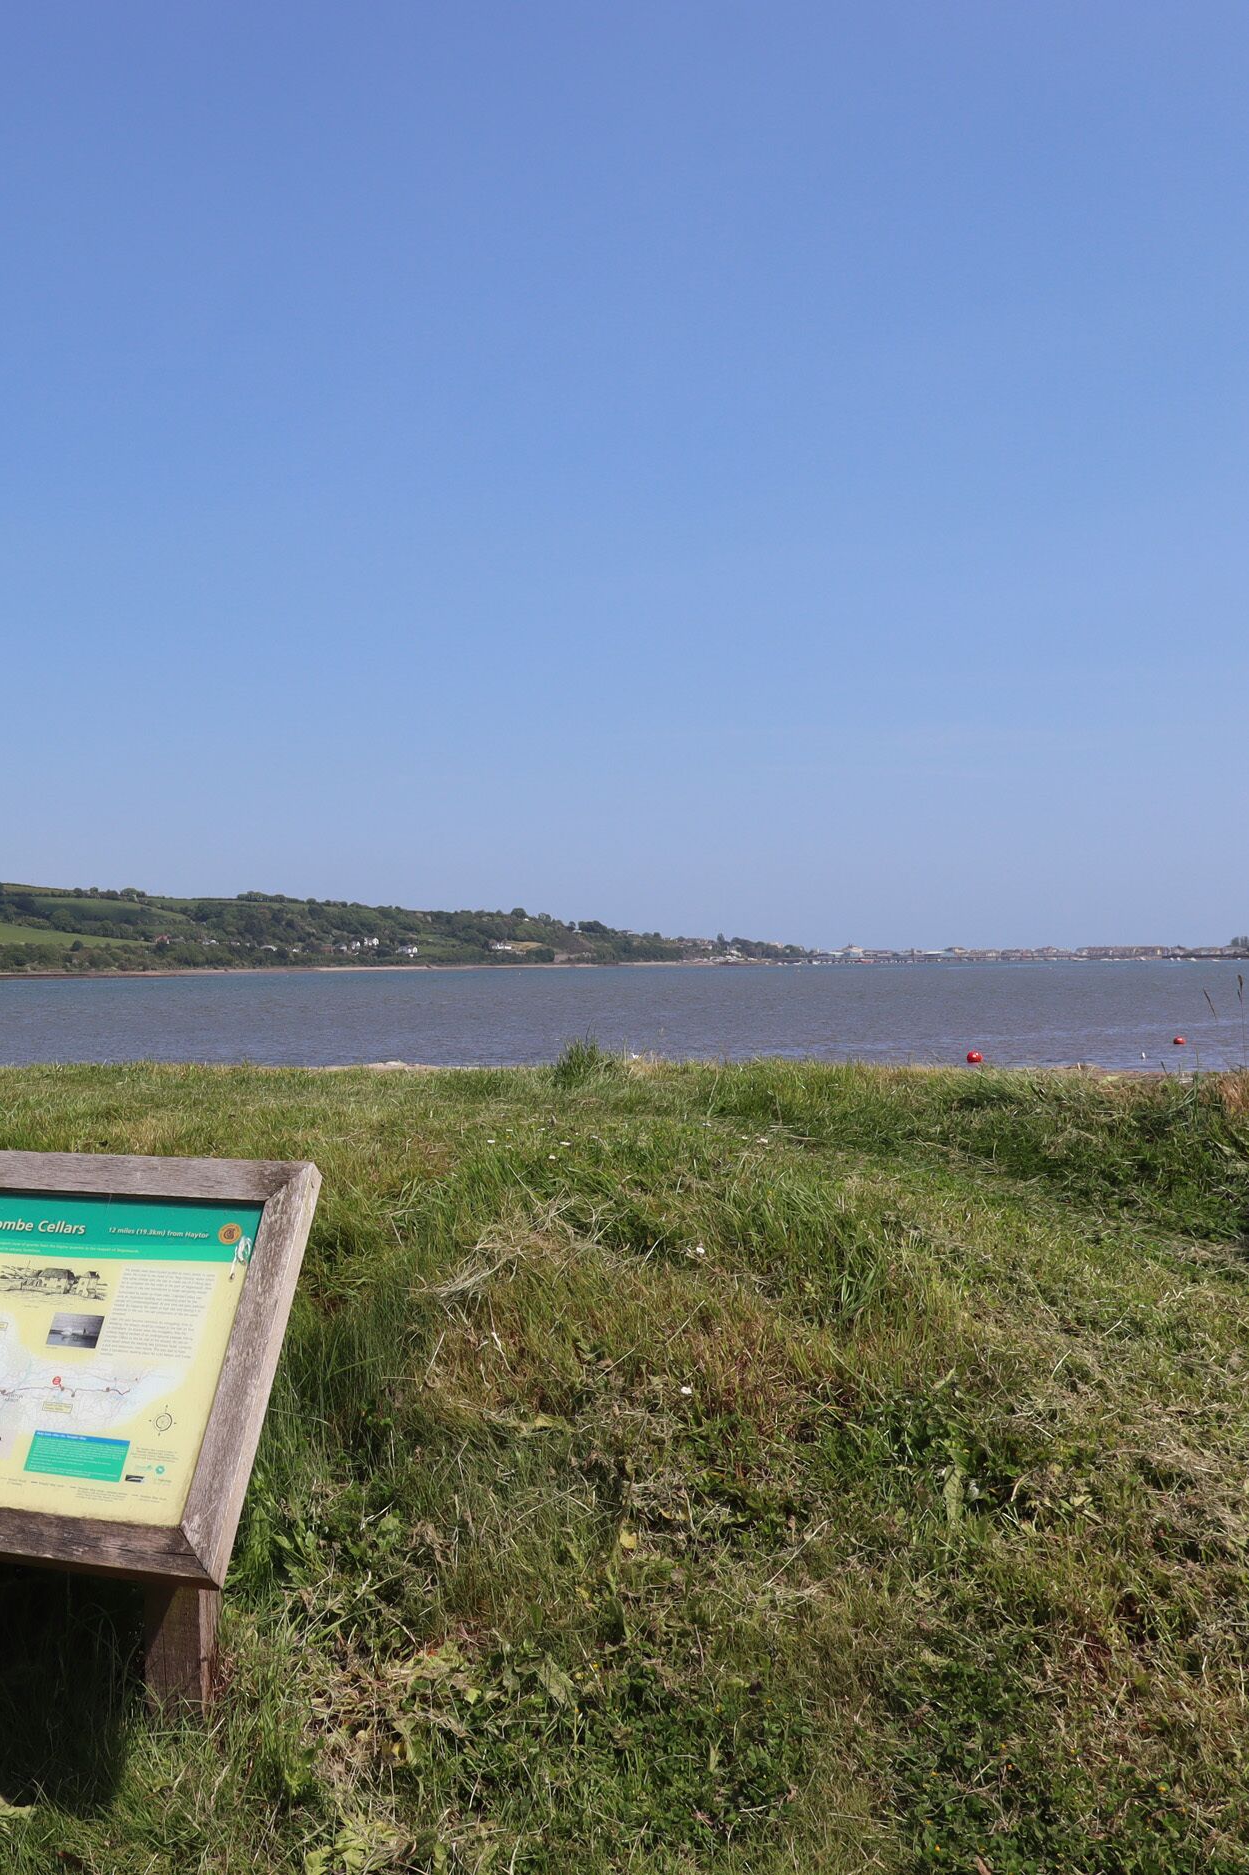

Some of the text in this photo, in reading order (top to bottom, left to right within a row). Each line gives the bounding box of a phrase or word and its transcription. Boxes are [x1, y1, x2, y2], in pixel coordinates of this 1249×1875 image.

[38, 1220, 86, 1235] Cellars
[108, 1226, 117, 1234] 12
[117, 1227, 135, 1235] miles
[167, 1229, 184, 1238] from
[185, 1231, 209, 1240] Haytor
